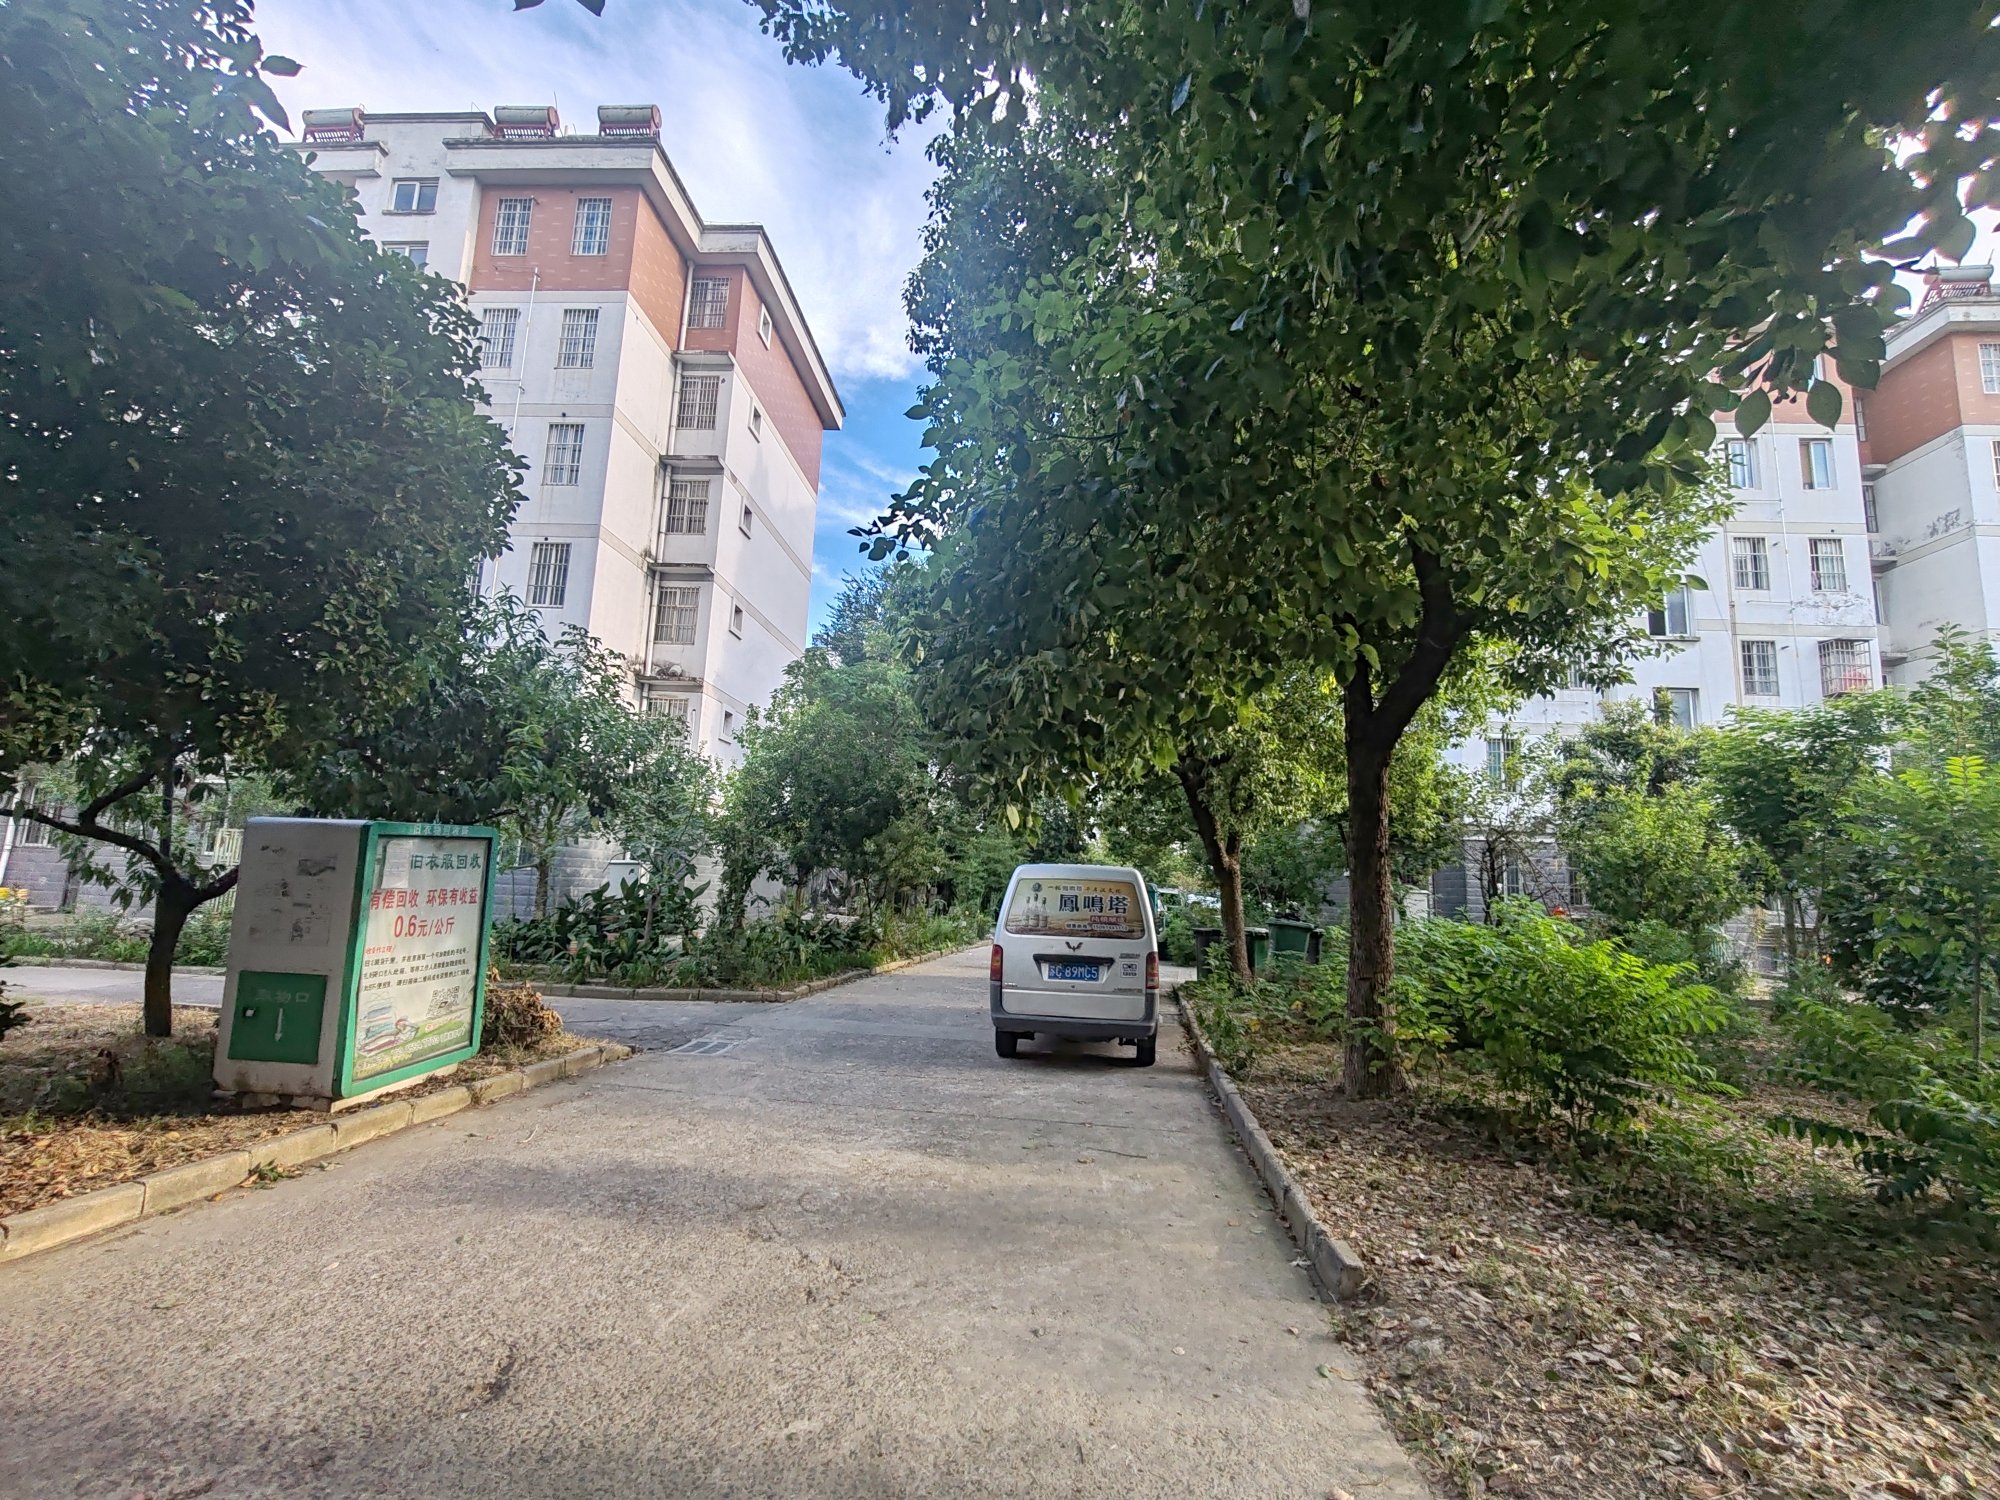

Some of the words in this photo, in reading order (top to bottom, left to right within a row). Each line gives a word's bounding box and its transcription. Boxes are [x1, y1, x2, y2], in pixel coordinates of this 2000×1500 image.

[411, 853, 482, 870] 旧衣服回收
[370, 889, 419, 910] 有偿回收
[426, 887, 478, 906] 环保有收益
[1058, 893, 1129, 914] 鳳鳴塔
[394, 914, 455, 938] 0.6元/公斤
